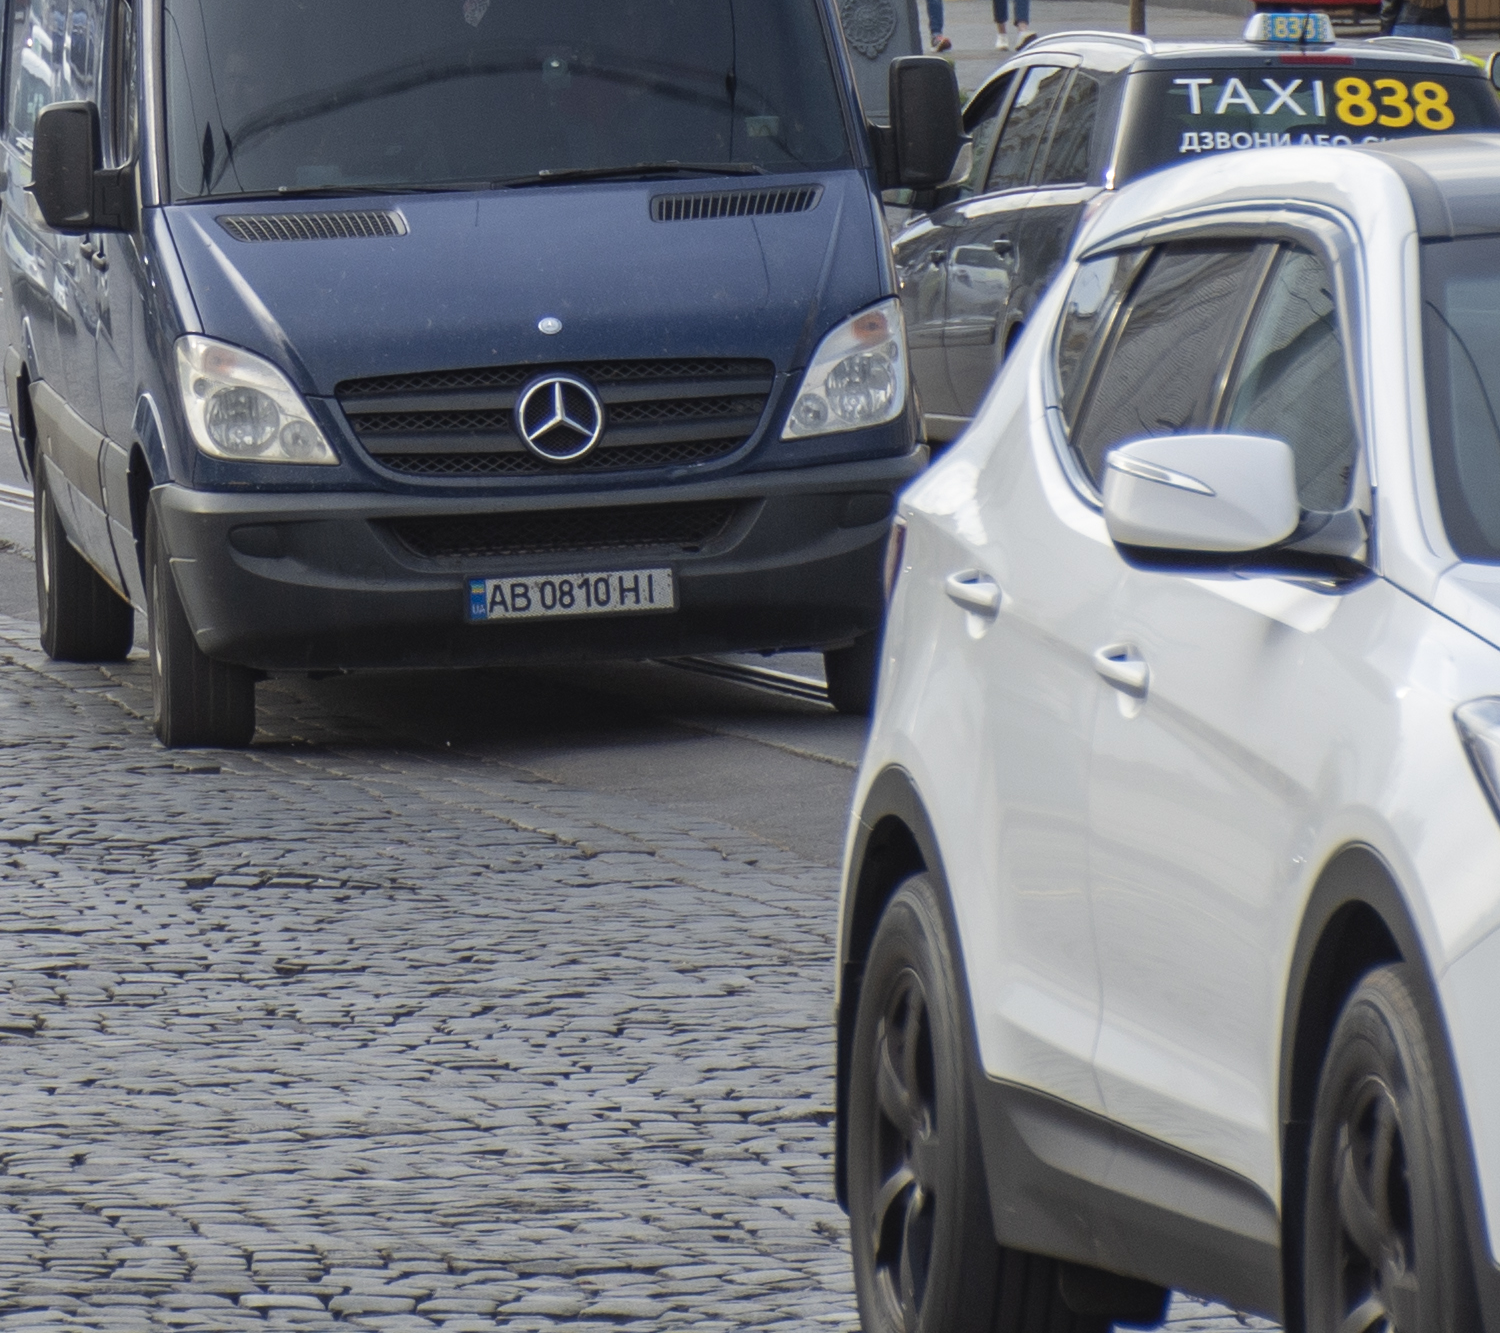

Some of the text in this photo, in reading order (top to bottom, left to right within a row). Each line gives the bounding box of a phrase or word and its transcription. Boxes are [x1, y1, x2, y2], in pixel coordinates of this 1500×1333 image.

[1334, 77, 1455, 130] 838
[1179, 132, 1291, 152] ДЗВОНИ
[488, 583, 531, 613] AB
[540, 576, 611, 610] 0810
